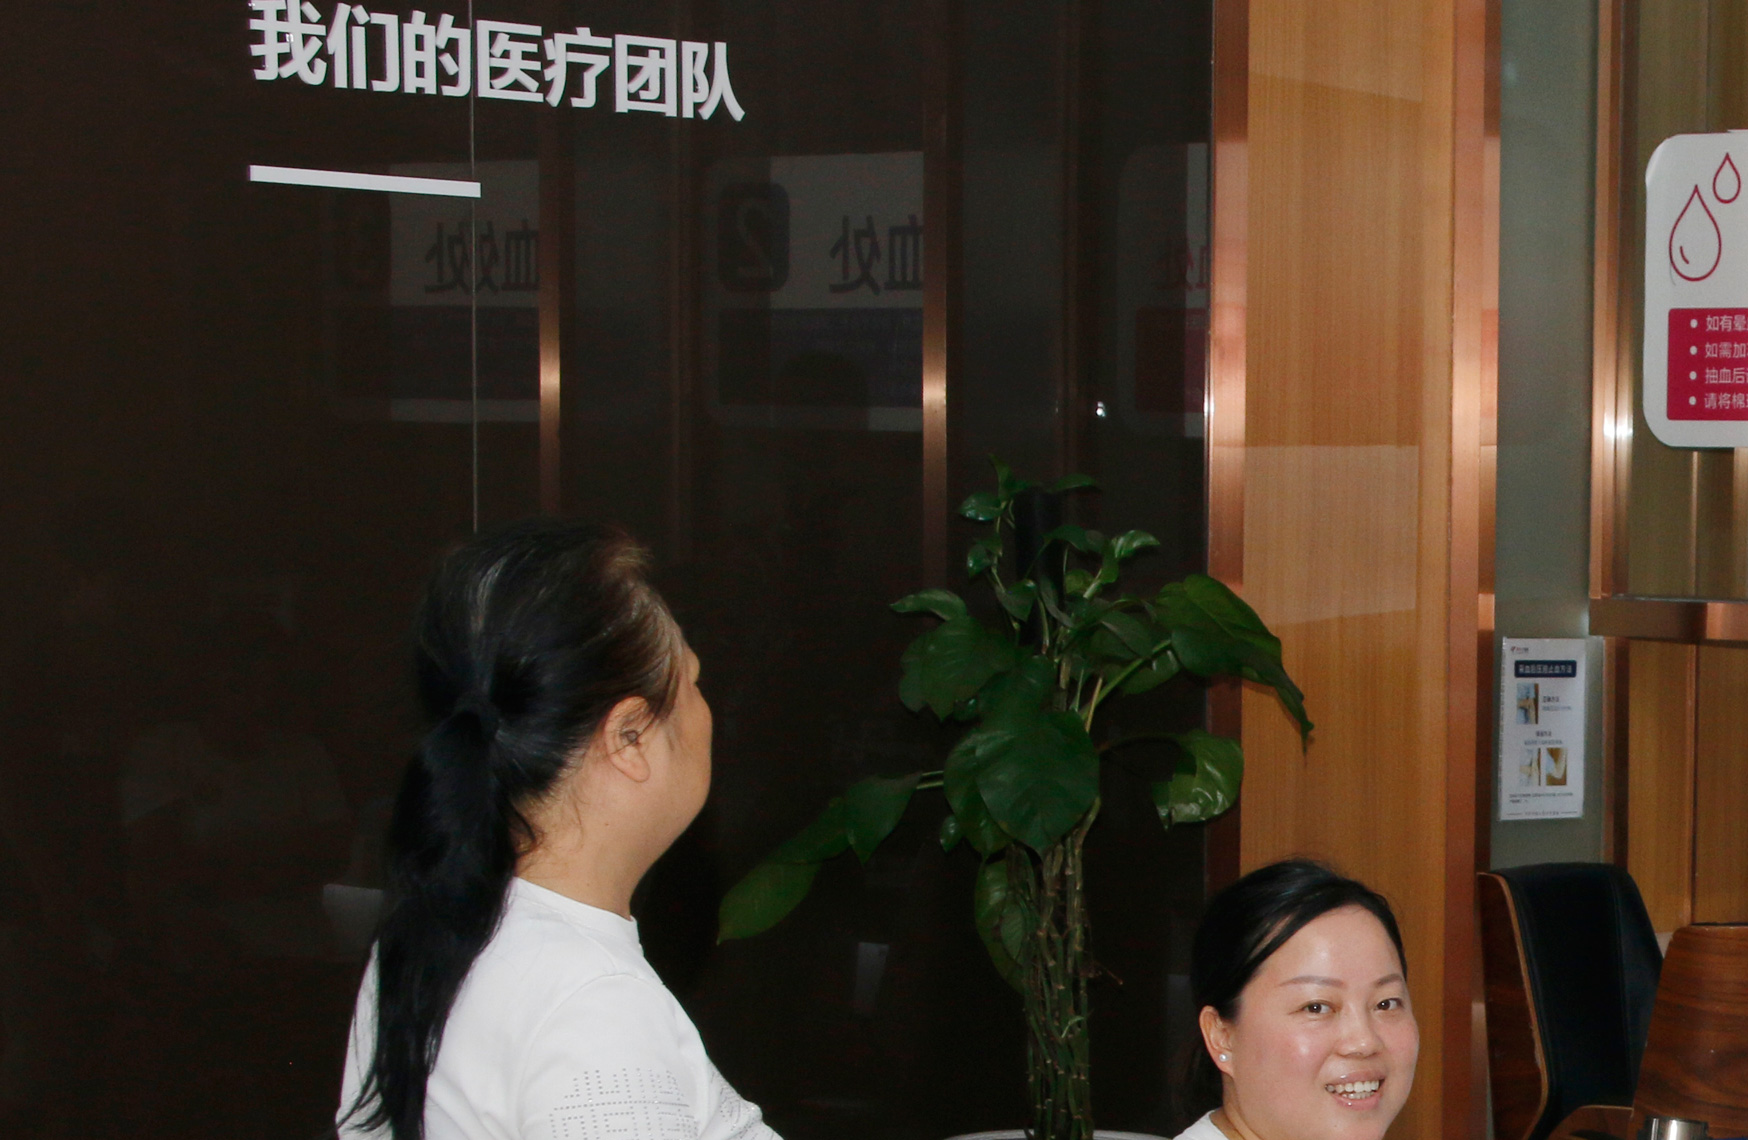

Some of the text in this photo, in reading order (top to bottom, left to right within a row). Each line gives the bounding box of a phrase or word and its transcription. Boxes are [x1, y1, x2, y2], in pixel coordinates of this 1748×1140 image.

[249, 0, 746, 122] 我们的医疗团队
